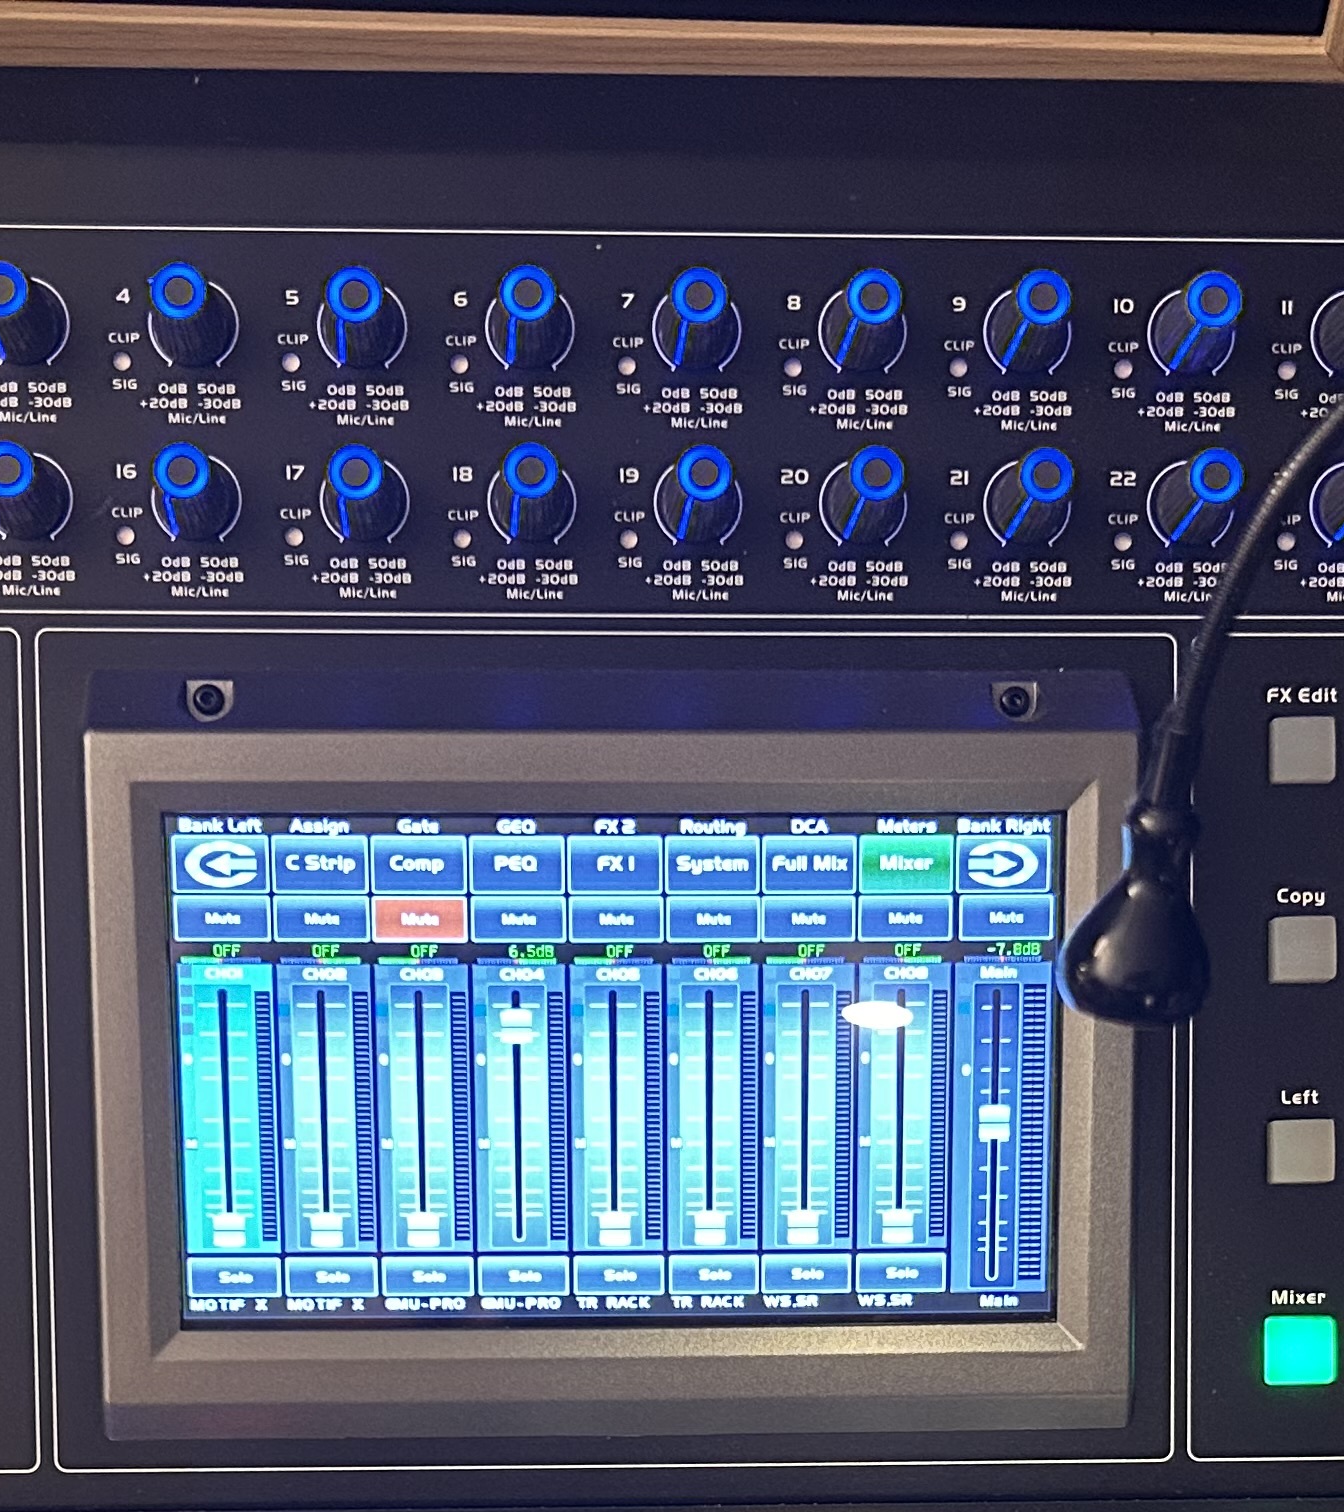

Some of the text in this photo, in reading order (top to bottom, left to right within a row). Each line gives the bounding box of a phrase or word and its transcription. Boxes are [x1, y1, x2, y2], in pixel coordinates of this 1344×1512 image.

[116, 288, 130, 303] 4
[454, 292, 467, 307] 6
[788, 295, 801, 310] 8
[944, 340, 974, 351] CLIP
[117, 464, 136, 479] 16
[781, 469, 809, 484] 20
[1110, 471, 1136, 486] 22
[1001, 591, 1056, 602] Mic/Line
[1267, 688, 1337, 703] FX Edit
[177, 817, 263, 833] Bank Left
[289, 819, 350, 835] Assign
[496, 819, 537, 834] GEQ
[680, 819, 746, 837] Routing
[791, 818, 830, 834] DCA
[957, 817, 1051, 835] Bank Right
[286, 855, 356, 874] C Strip
[390, 855, 444, 874] Comp
[494, 855, 537, 871] PEQ
[676, 855, 749, 875] System
[772, 855, 848, 871] Full Mix
[880, 854, 933, 871] Mixer
[1277, 888, 1325, 906] Copy
[509, 945, 554, 958] 6.5dB
[894, 944, 921, 957] OFF
[1282, 1090, 1318, 1104] Left
[980, 1294, 1019, 1307] Main
[1272, 1290, 1325, 1304] Mixer
